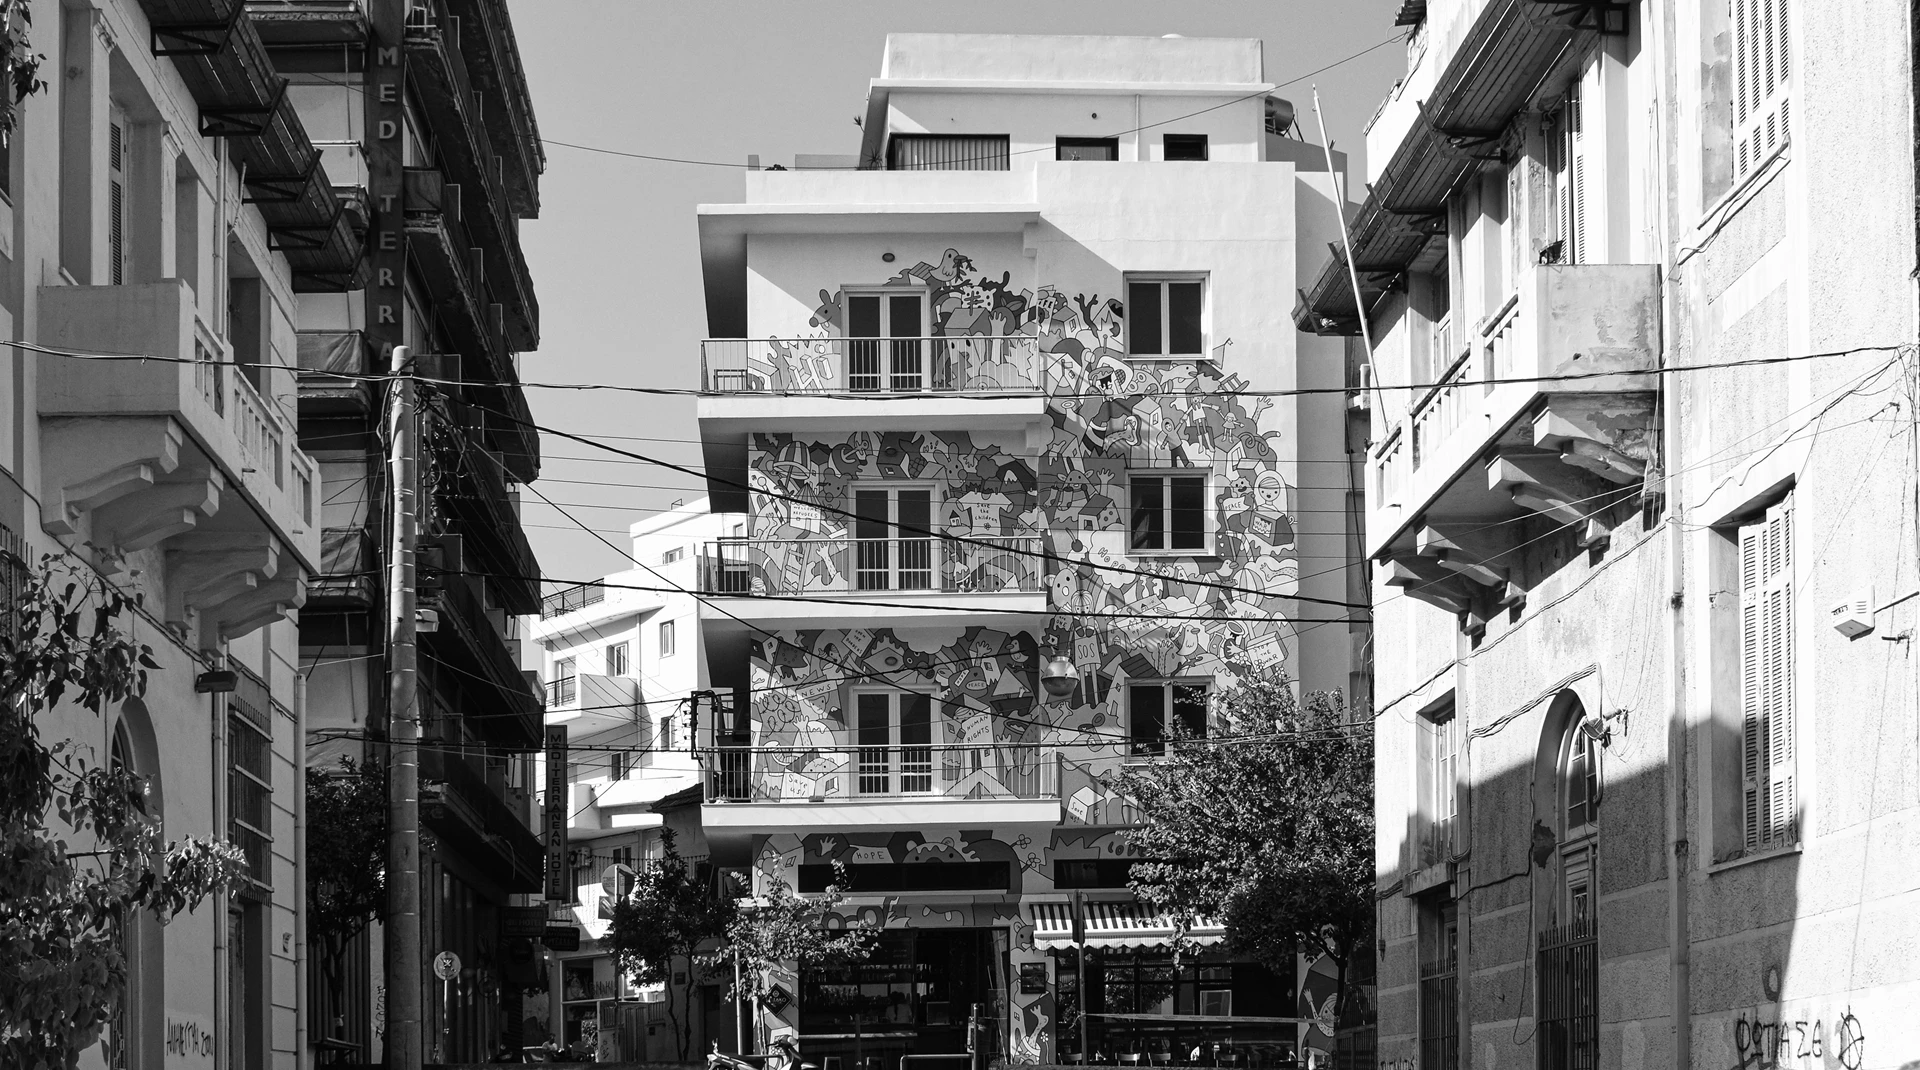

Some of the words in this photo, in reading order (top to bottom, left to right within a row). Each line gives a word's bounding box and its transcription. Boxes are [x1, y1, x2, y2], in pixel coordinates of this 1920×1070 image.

[1077, 642, 1096, 660] SOS
[801, 684, 831, 697] NEWS
[966, 715, 989, 731] HUMAN
[966, 726, 991, 743] RIGHTS
[856, 851, 885, 860] HOPE
[551, 852, 561, 895] HOTEL
